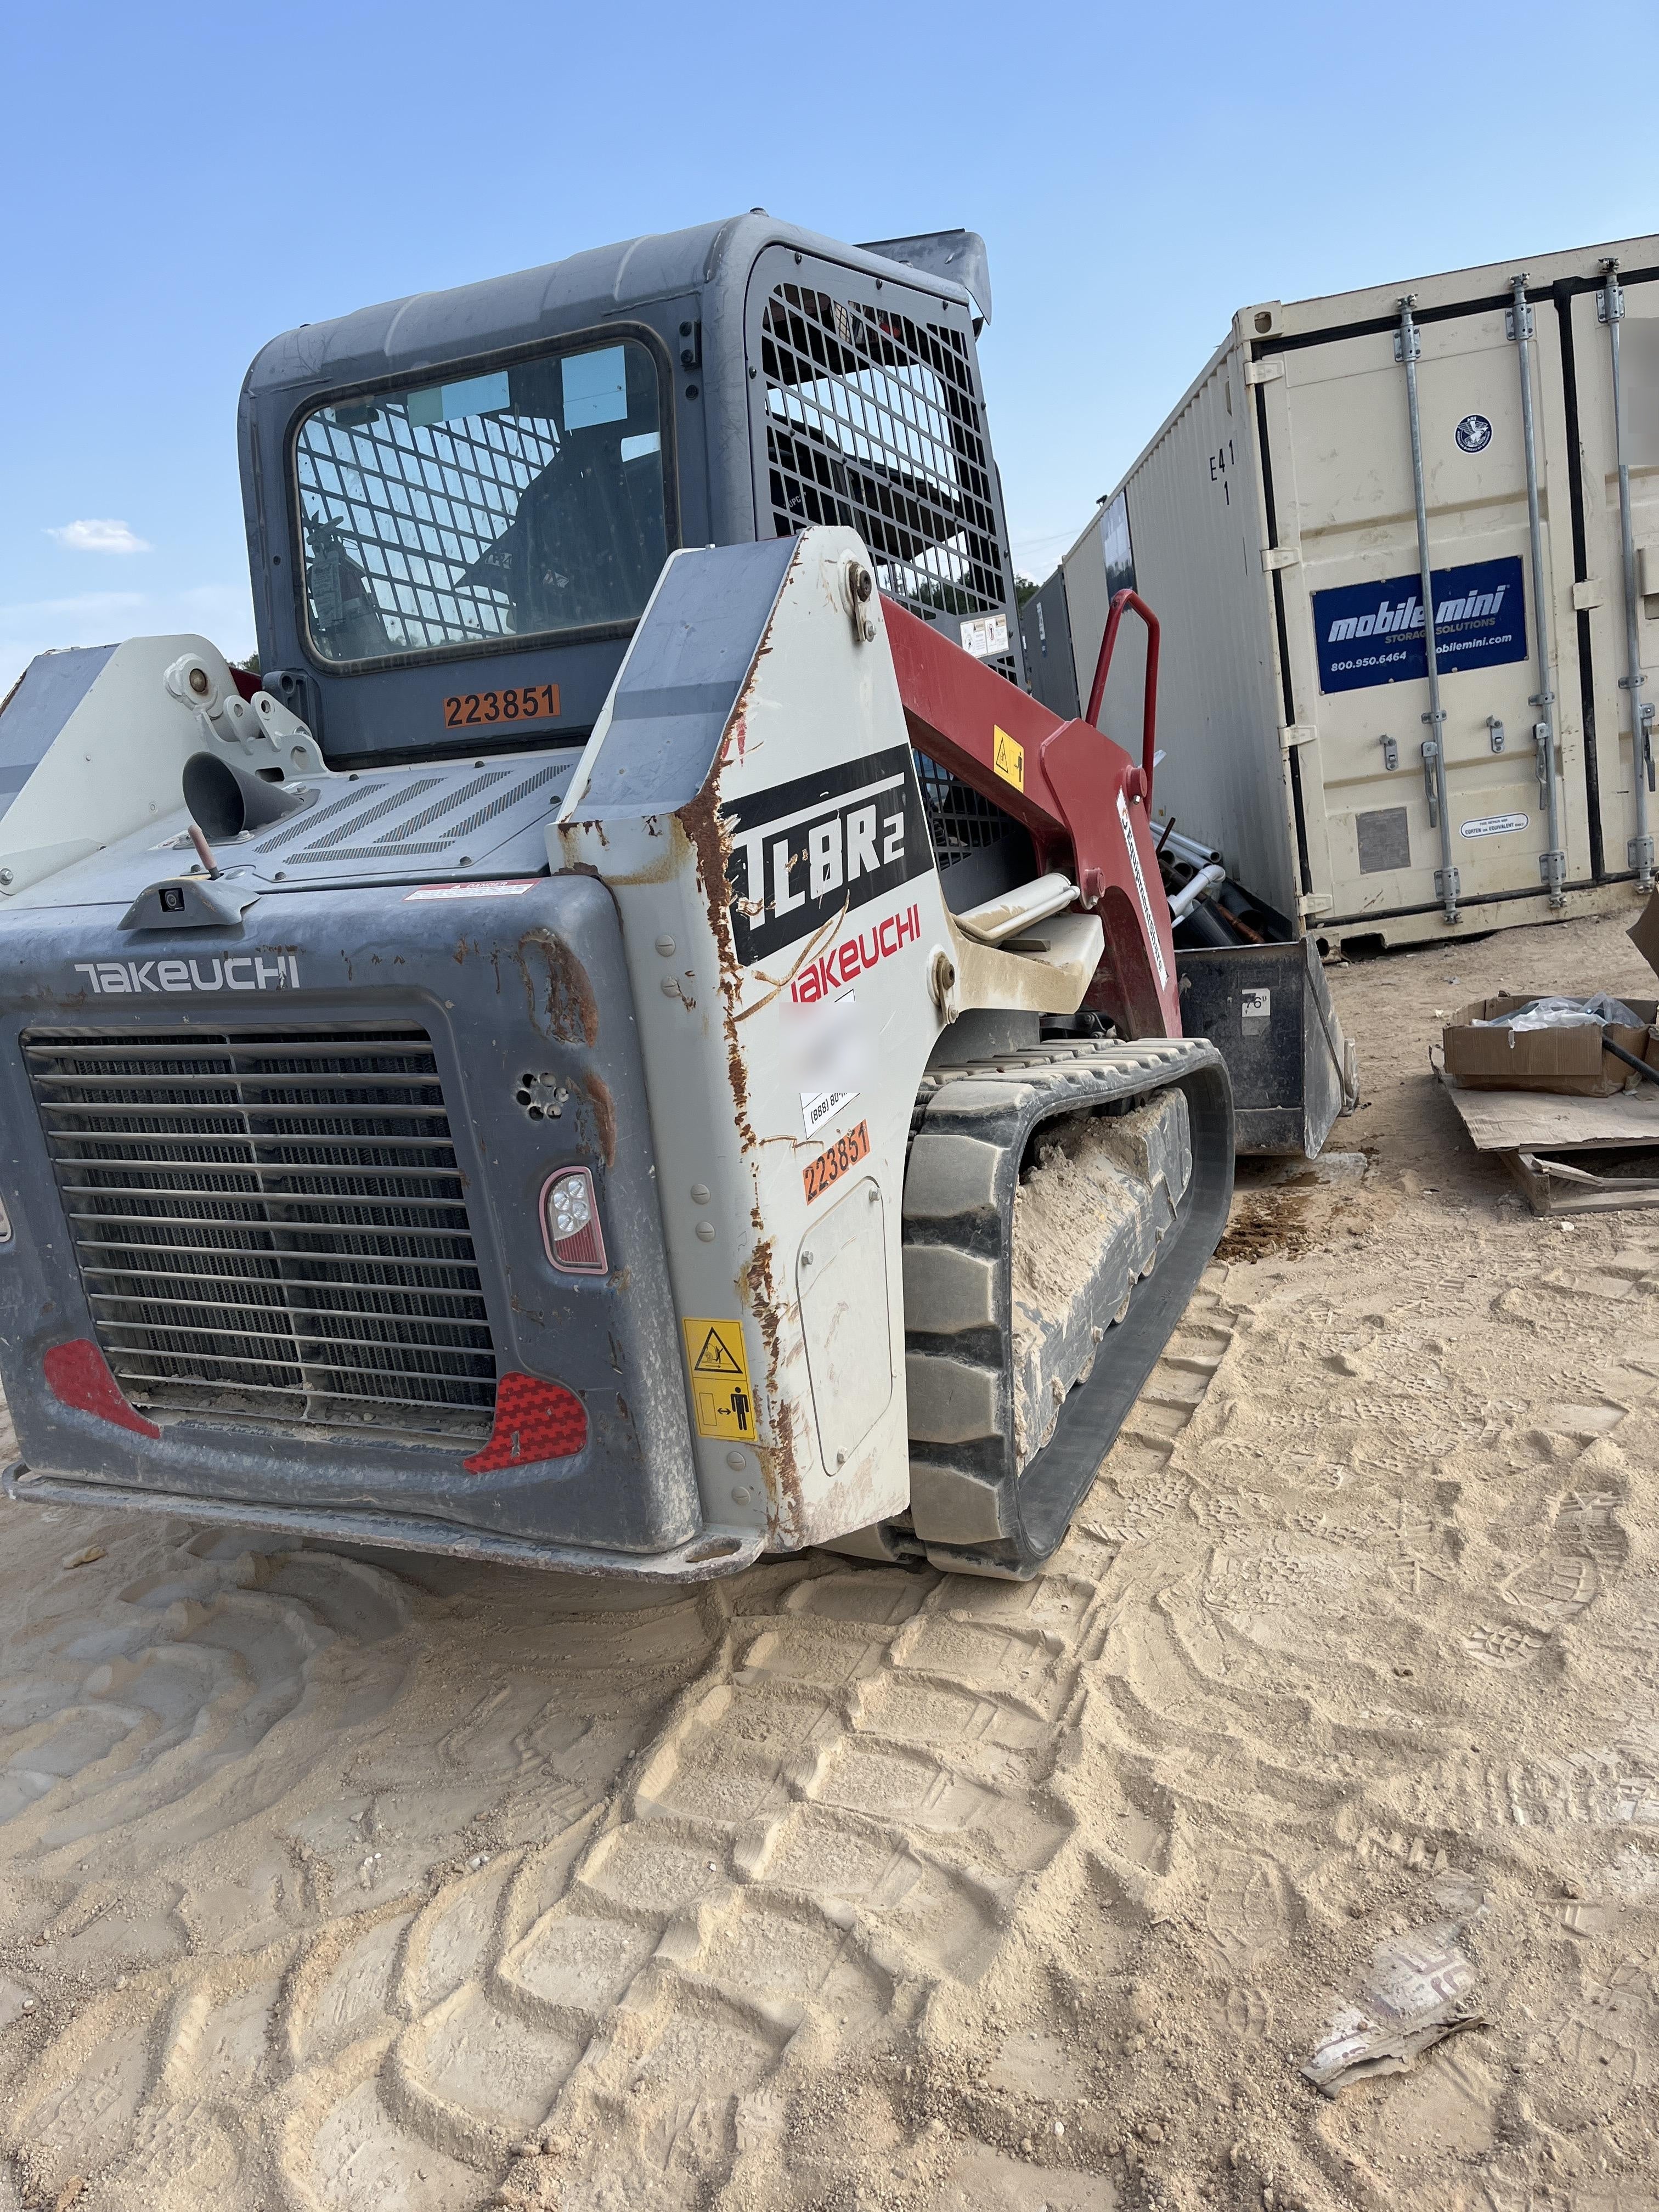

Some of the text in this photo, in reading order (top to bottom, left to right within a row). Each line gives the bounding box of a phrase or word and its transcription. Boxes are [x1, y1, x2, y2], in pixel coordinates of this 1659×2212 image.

[1328, 585, 1506, 642] mobile mini
[1385, 617, 1496, 644] STORAG SOLUTIONS
[1331, 634, 1512, 672] 800.950.6464 obilemini.com
[446, 685, 554, 726] 223851
[811, 1098, 829, 1124] (888)
[805, 1122, 867, 1201] 223851
